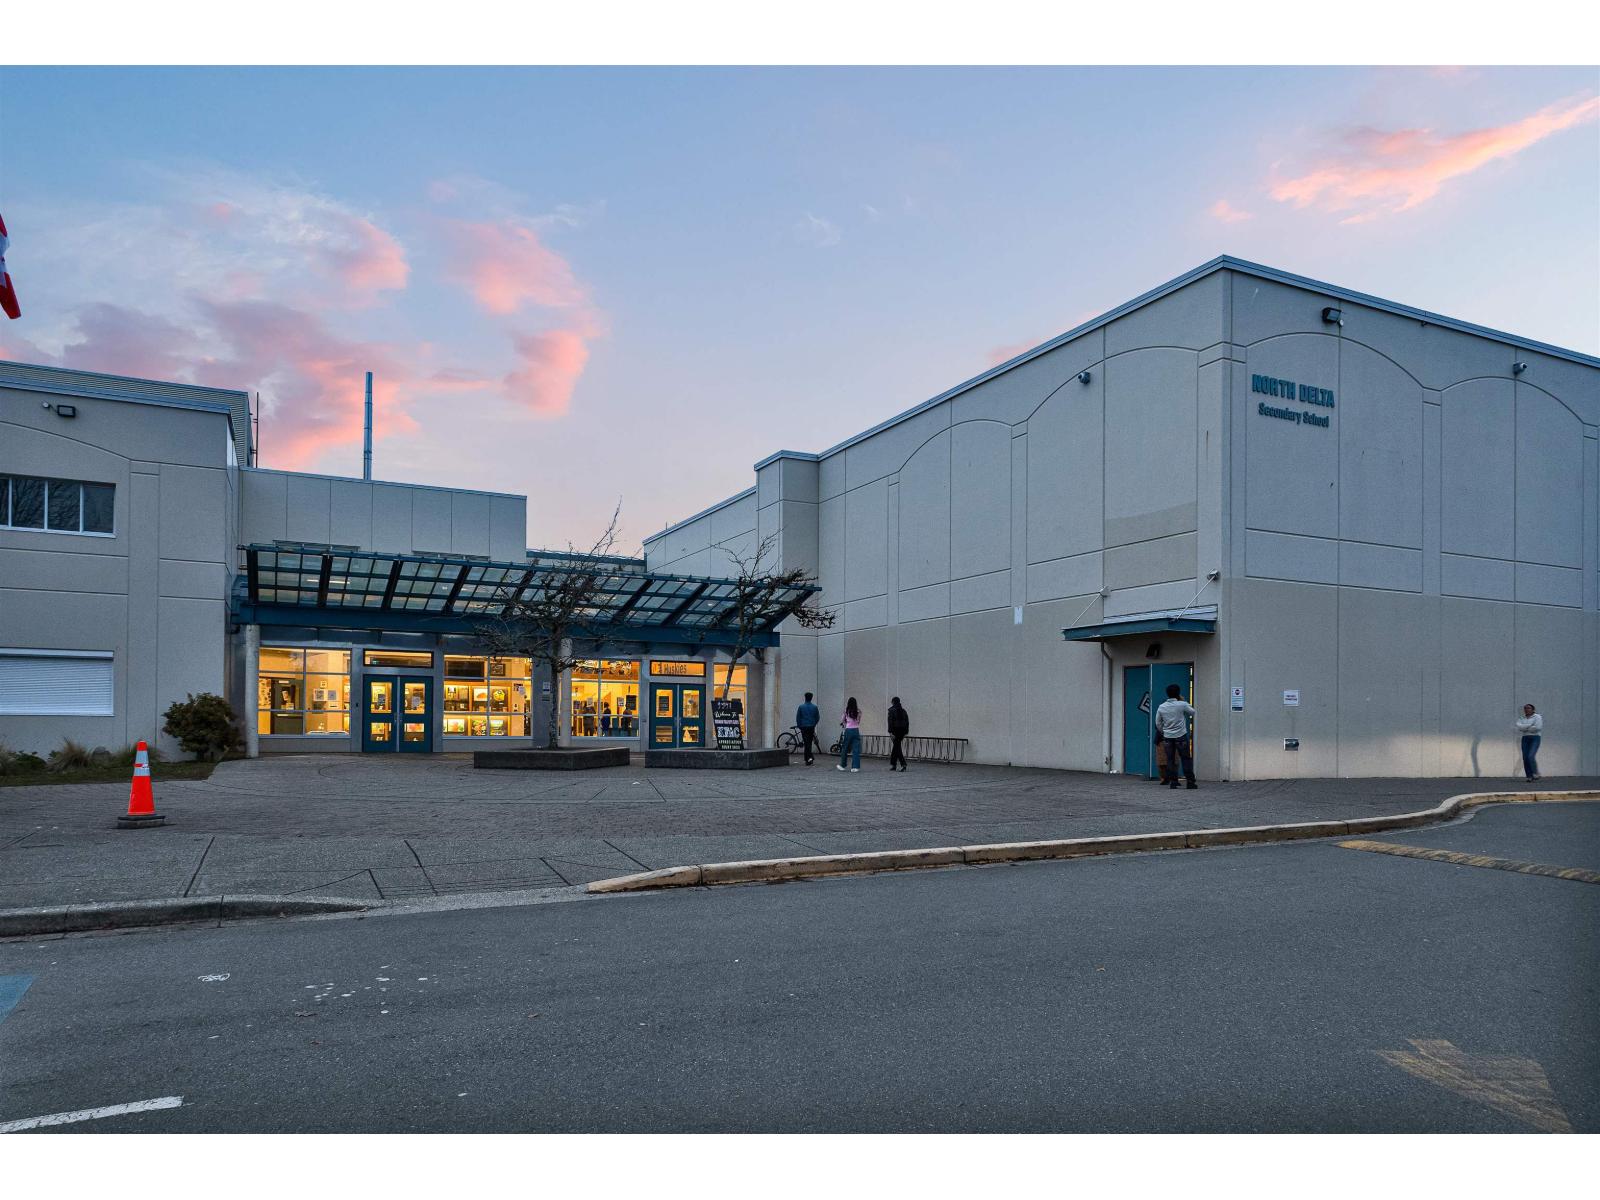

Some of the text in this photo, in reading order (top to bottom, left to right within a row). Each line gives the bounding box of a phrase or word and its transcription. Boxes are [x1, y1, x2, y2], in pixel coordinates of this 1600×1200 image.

[1252, 374, 1335, 409] NORTH DELTA
[1258, 402, 1330, 428] Secondary School
